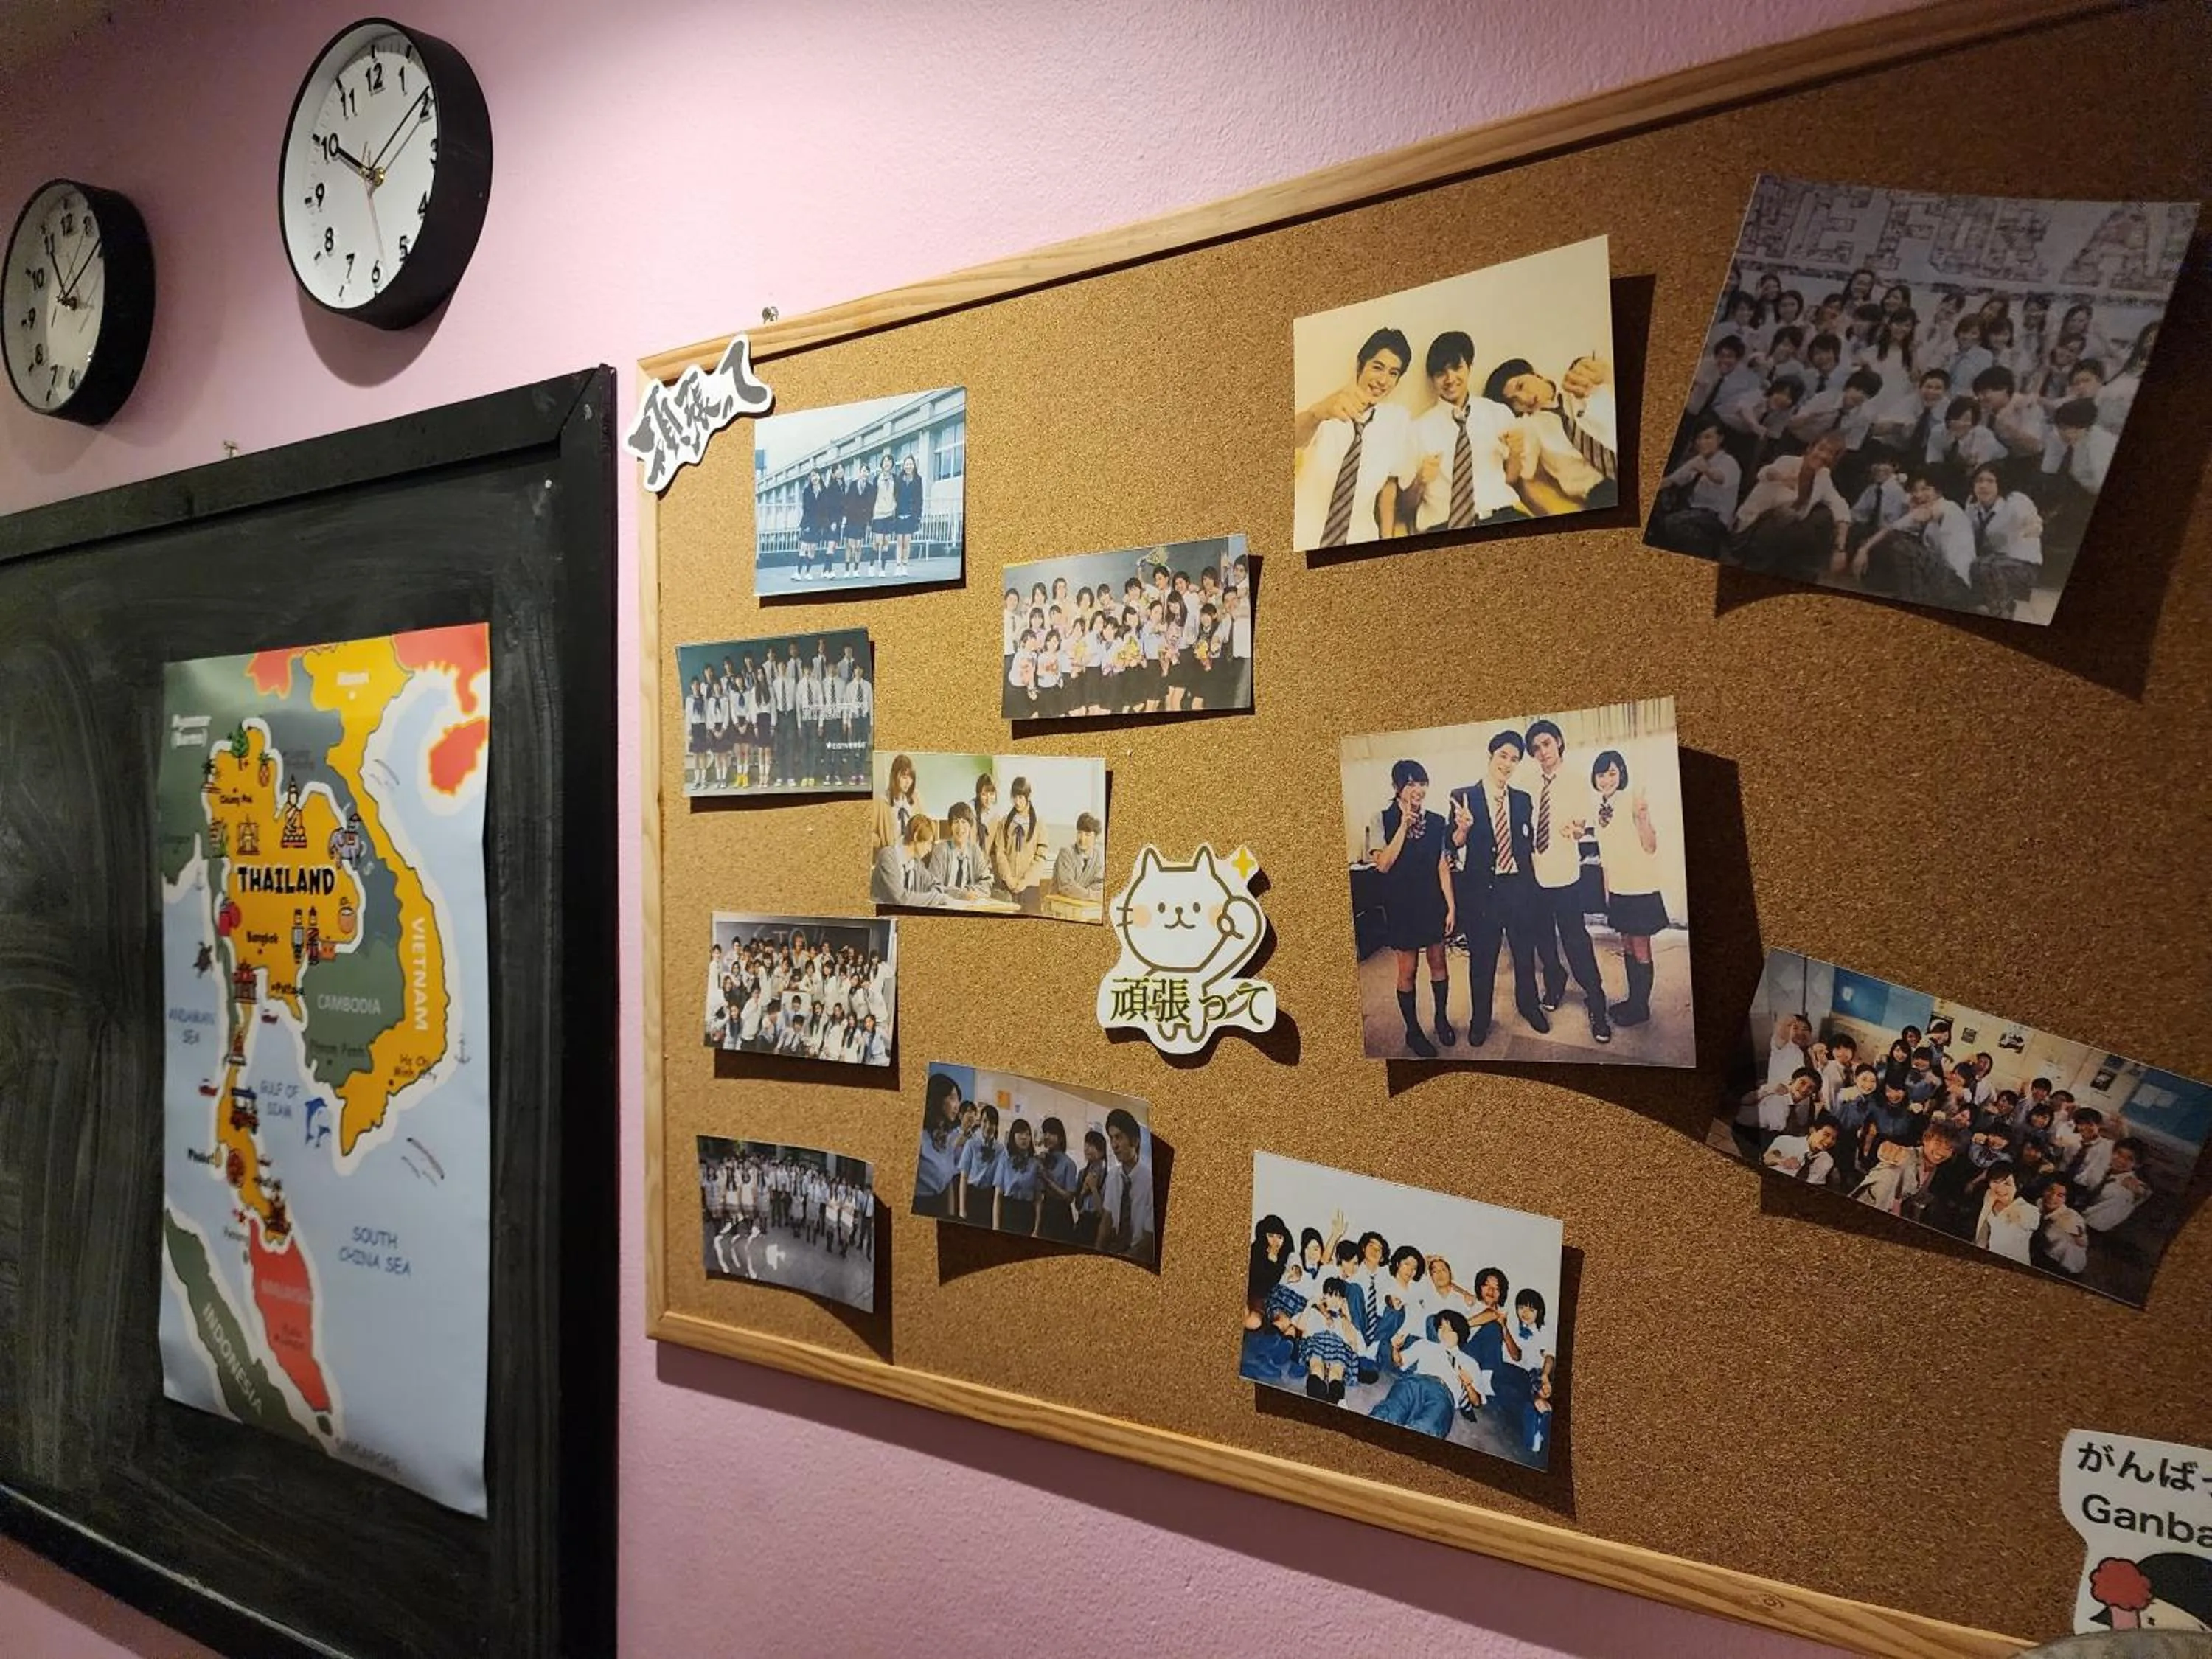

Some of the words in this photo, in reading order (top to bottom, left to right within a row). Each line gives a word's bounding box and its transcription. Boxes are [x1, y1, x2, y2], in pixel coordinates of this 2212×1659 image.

[366, 63, 384, 91] 12
[399, 66, 406, 92] 1
[341, 88, 356, 116] 11
[419, 94, 434, 119] 2
[321, 133, 338, 161] 10
[315, 183, 325, 209] 9
[417, 191, 429, 215] 4
[61, 213, 73, 237] 12
[44, 234, 55, 256] 11
[324, 227, 334, 252] 8
[399, 235, 410, 262] 5
[32, 268, 44, 291] 10
[346, 254, 355, 280] 7
[372, 260, 380, 284] 6
[27, 308, 36, 330] 9
[35, 344, 44, 365] 8
[50, 364, 58, 386] 7
[237, 867, 335, 895] THAILAND
[412, 917, 429, 1031] VIETNAM
[317, 995, 381, 1015] CAMBODIA
[1110, 977, 1268, 1026] 頑張って
[352, 1226, 398, 1249] SOUTH
[339, 1248, 380, 1269] CHINA
[386, 1255, 412, 1277] SEA
[203, 1303, 262, 1416] INDONESIA
